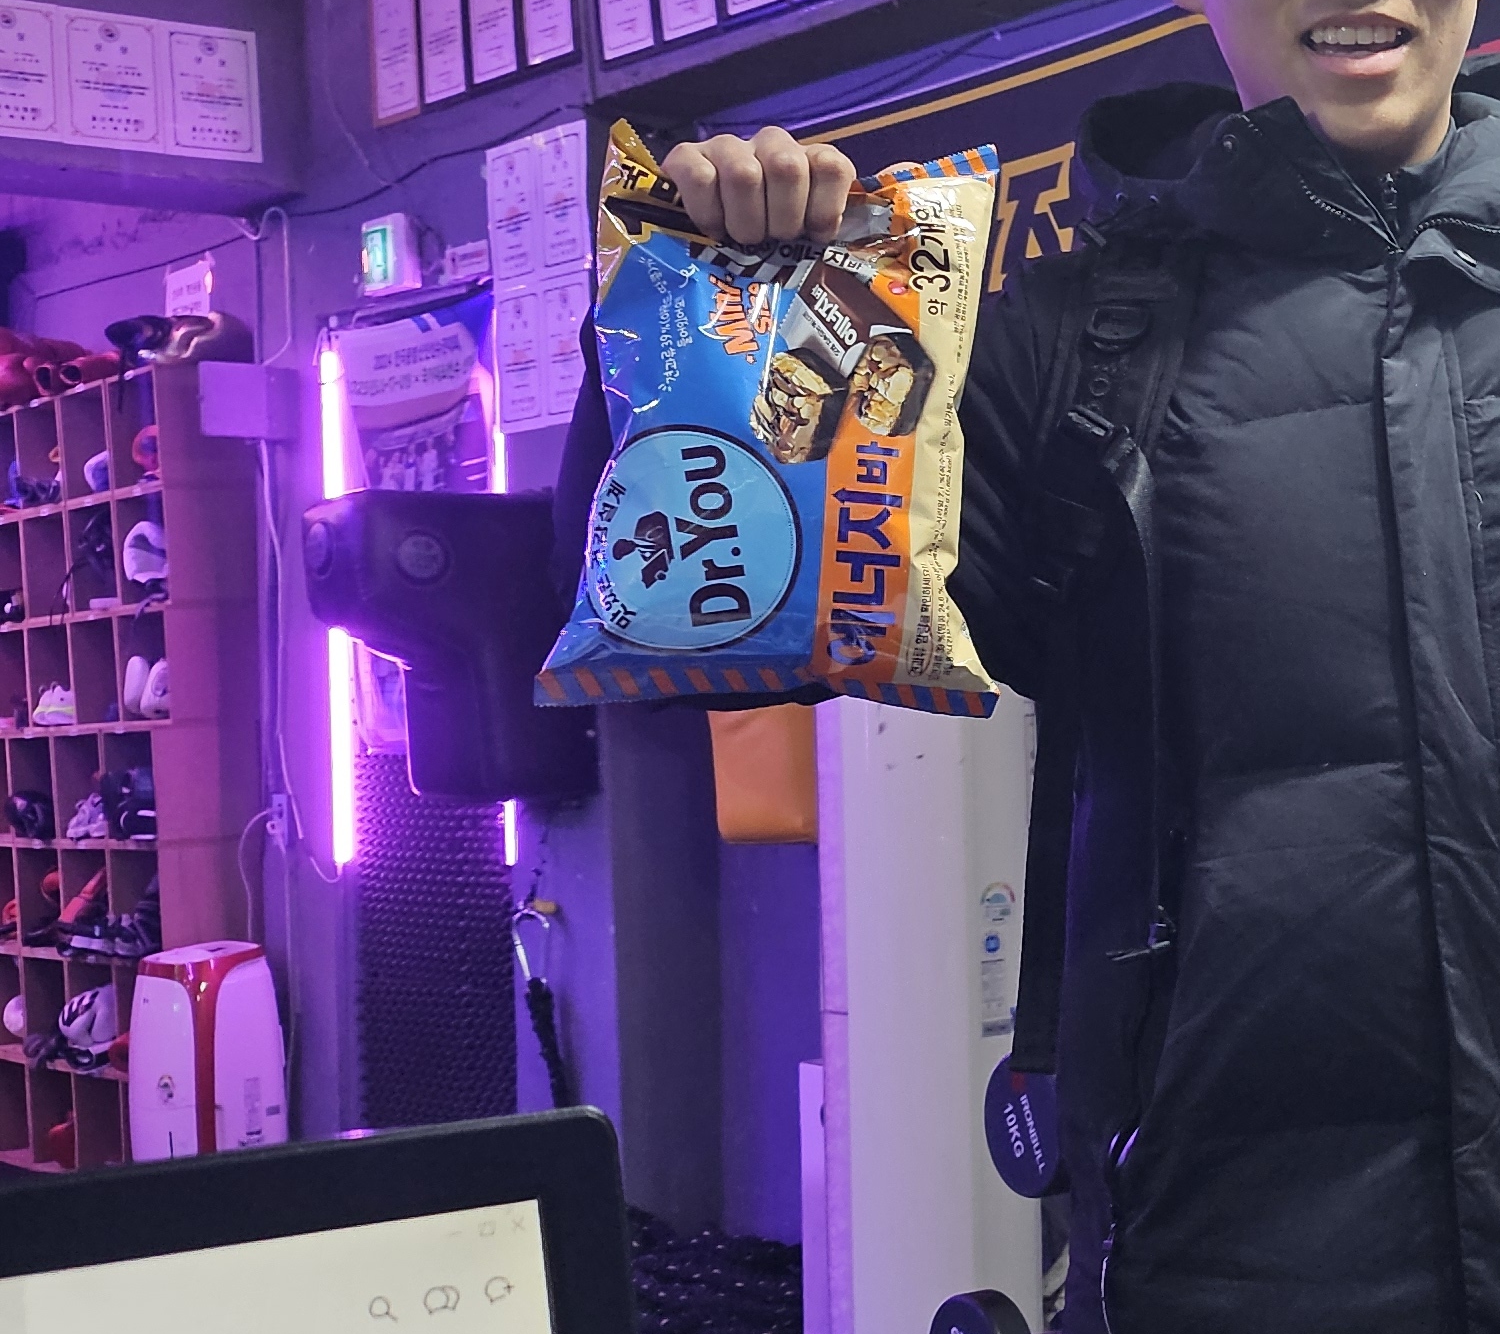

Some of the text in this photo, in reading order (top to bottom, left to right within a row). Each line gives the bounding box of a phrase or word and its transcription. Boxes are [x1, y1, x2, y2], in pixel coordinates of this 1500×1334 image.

[810, 284, 857, 348] 에너지바
[928, 299, 948, 315] 약
[679, 443, 752, 628] Dr.You
[826, 441, 903, 665] 에너지바
[1003, 1102, 1025, 1159] 10KG
[1020, 1093, 1046, 1175] IRONBULL
